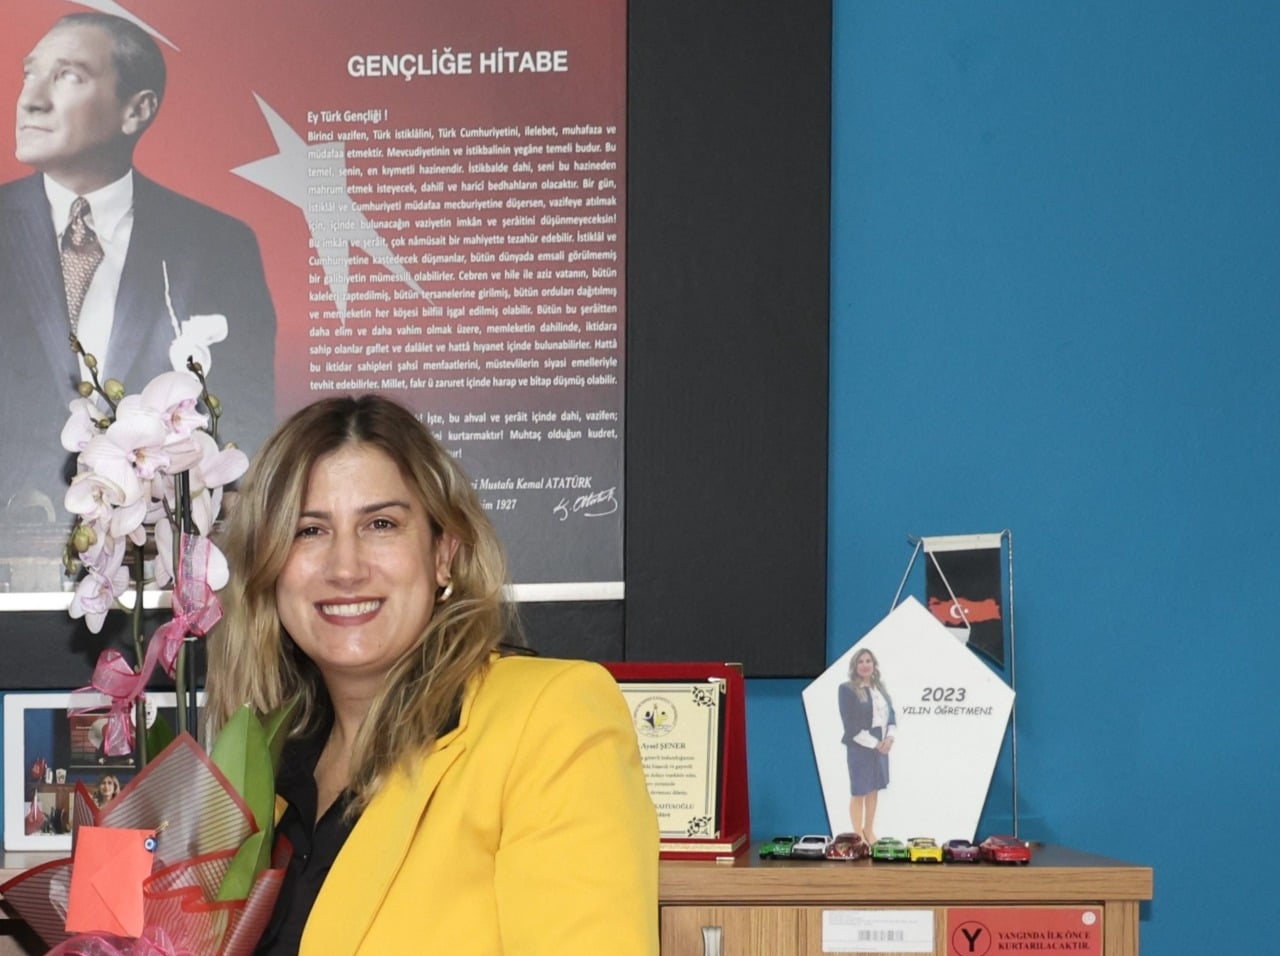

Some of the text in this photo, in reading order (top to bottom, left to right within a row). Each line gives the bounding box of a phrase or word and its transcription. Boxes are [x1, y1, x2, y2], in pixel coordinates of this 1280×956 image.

[347, 47, 568, 82] GENÇLİĞE HİTABE
[307, 109, 319, 125] Ey
[320, 109, 342, 122] Türk
[343, 108, 382, 124] Gençliği
[307, 124, 616, 142] Birinci vazifen, Türk istiklâlini, Türk Cumhuriyetini, ilelebet, muhafaza ve
[346, 147, 384, 158] etmektir.
[386, 145, 450, 160] Mevcudiyetinin
[452, 148, 463, 156] ve
[513, 143, 543, 156] yegâne
[545, 143, 573, 154] temeli
[574, 142, 602, 153] budur.
[604, 142, 616, 152] Bu
[308, 249, 617, 269] Cumhuriyetine kastedecek düşmanlar, bütün dünyada emsali görülmemiş
[393, 289, 418, 300] bütün
[422, 288, 476, 299] tersanelerine
[477, 287, 511, 300] girilmiş,
[513, 286, 539, 297] bütün
[540, 286, 574, 297] orduları
[576, 285, 617, 298] dağıtılmış
[309, 326, 330, 337] daha
[356, 328, 367, 336] ve
[371, 325, 392, 335] daha
[396, 324, 422, 335] vahim
[426, 324, 452, 334] olmak
[456, 323, 482, 335] üzere,
[486, 322, 536, 333] memleketin
[539, 321, 581, 334] dahilinde,
[585, 321, 617, 331] iktidara
[309, 379, 334, 390] tevhit
[335, 379, 380, 390] edebilirler.
[380, 378, 408, 390] Millet,
[409, 378, 426, 388] fakr
[434, 377, 465, 388] zaruret
[465, 377, 491, 390] içinde
[492, 376, 517, 389] harap
[552, 375, 585, 388] düşmüş
[586, 374, 617, 385] olabilir.
[426, 412, 445, 426] İşte,
[448, 413, 460, 423] bu
[463, 412, 487, 423] ahval
[489, 414, 500, 422] ve
[504, 411, 528, 425] şerâit
[531, 411, 557, 424] içinde
[560, 410, 582, 423] dahi,
[585, 410, 618, 422] vazifen;
[447, 430, 504, 441] kurtarmaktır!
[509, 429, 542, 442] Muhtaç
[547, 428, 582, 442] olduğun
[587, 427, 618, 440] kudret,
[479, 478, 514, 490] Mustafa
[516, 477, 544, 490] Kemal
[545, 475, 592, 489] ATATÜRK
[496, 499, 518, 510] 1927
[921, 687, 967, 702] 2023
[902, 705, 993, 715] YILIN ÖĞRETMENİ
[960, 928, 983, 953] Y
[998, 930, 1091, 940] YANGINDA İLK ÖNCE
[998, 942, 1090, 950] KURTARILACAKTIR.
